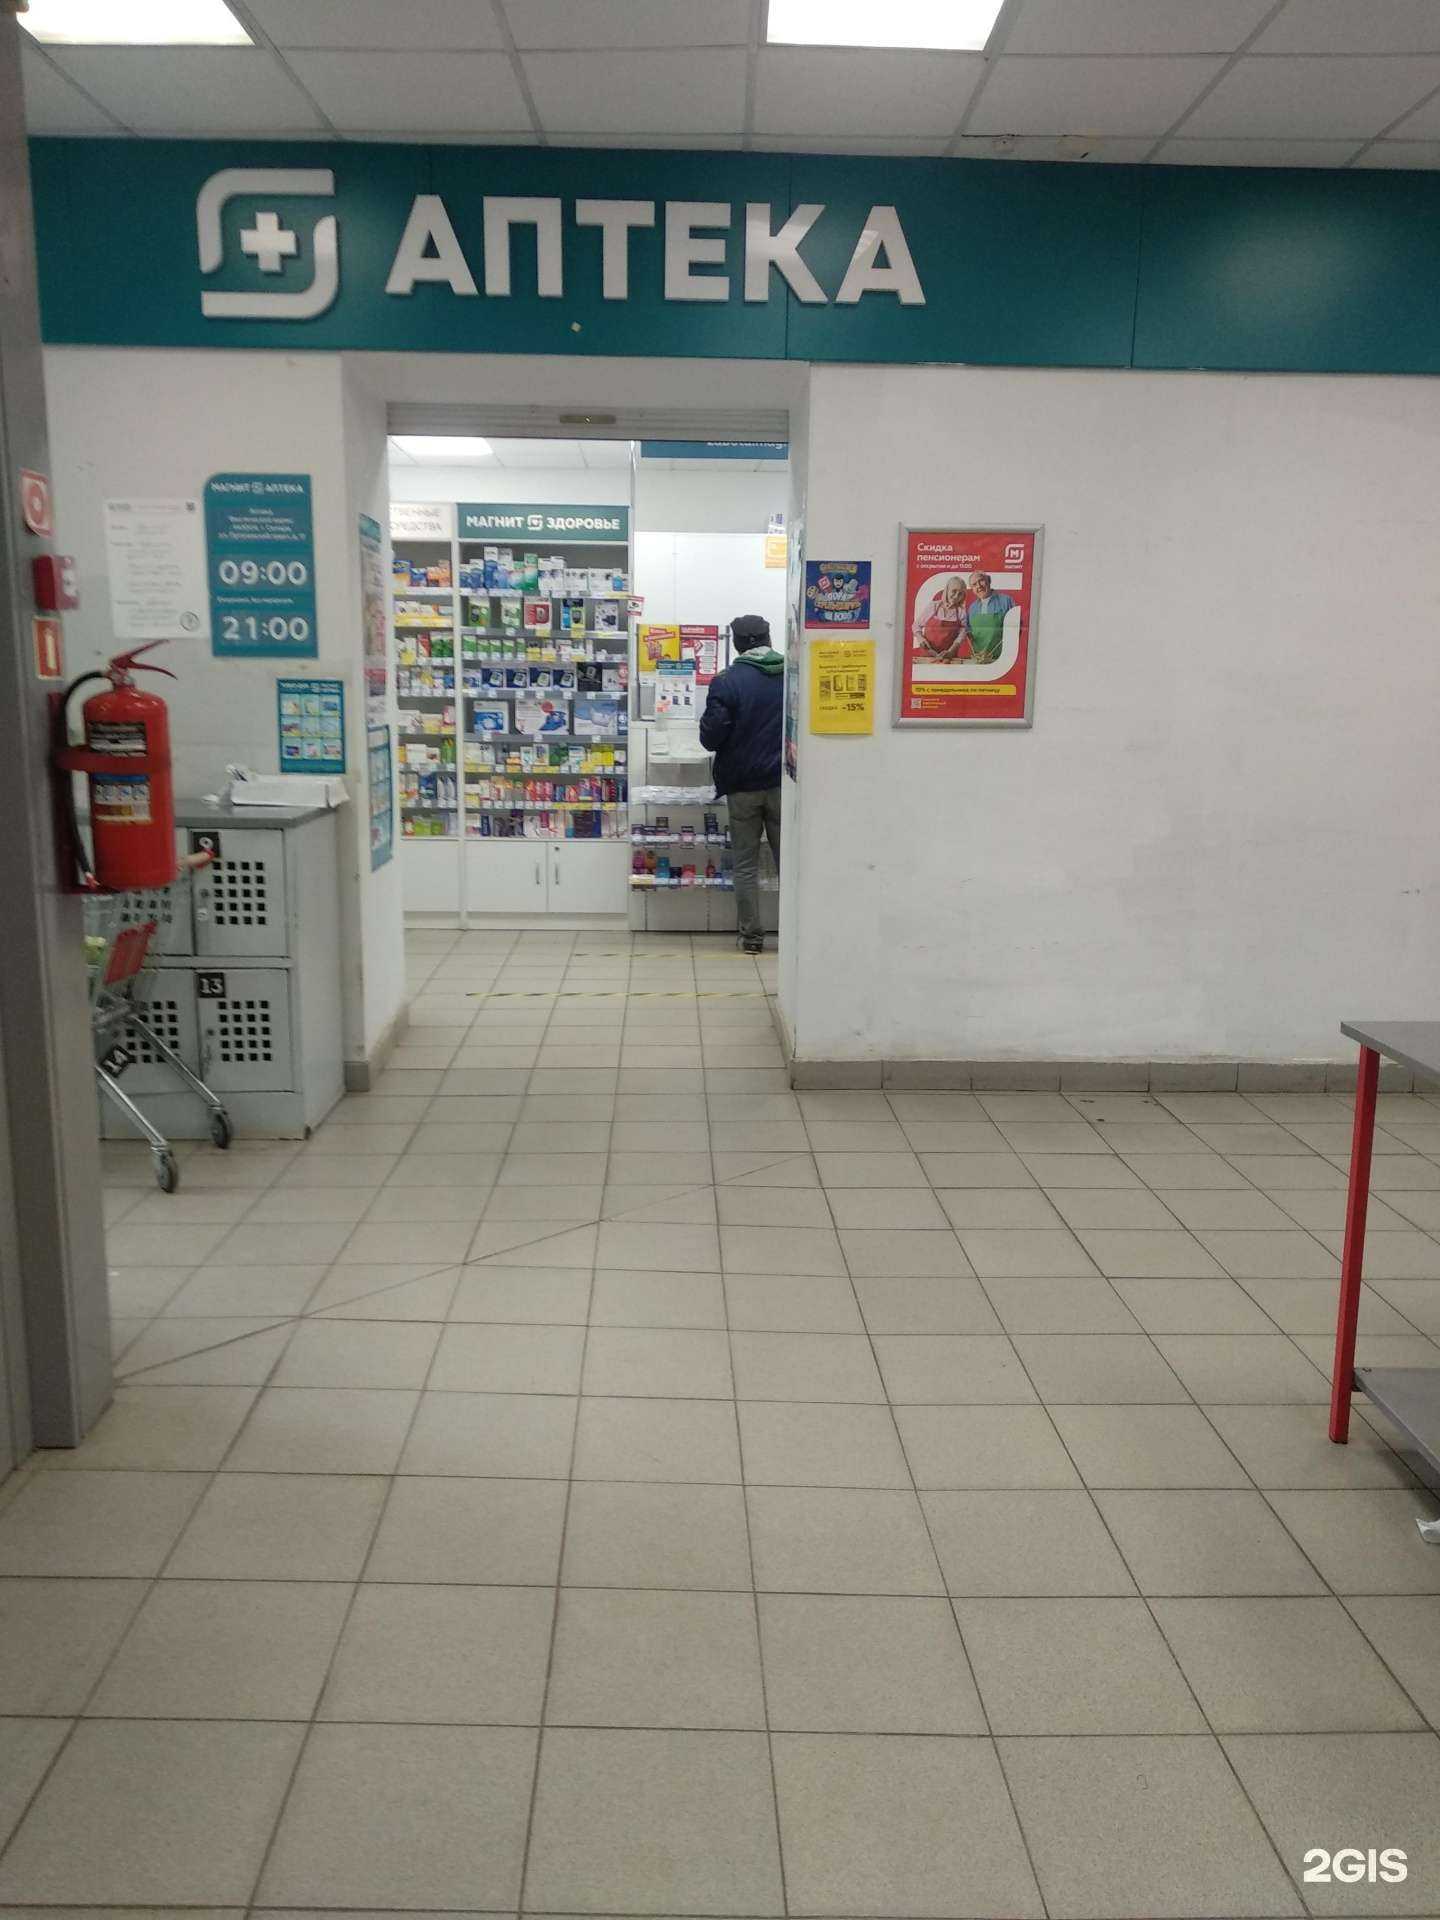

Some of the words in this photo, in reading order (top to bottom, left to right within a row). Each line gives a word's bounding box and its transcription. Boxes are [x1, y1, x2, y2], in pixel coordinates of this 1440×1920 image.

[386, 194, 927, 305] АПТЕКА
[466, 514, 525, 528] МАГНИТ
[546, 517, 621, 530] ЗДОРОВЬЕ
[917, 542, 953, 553] Скидка
[917, 553, 981, 564] пенсионерам
[218, 560, 307, 585] 09:00
[222, 615, 309, 641] 21:00
[841, 703, 865, 712] -15%
[200, 977, 224, 994] 13
